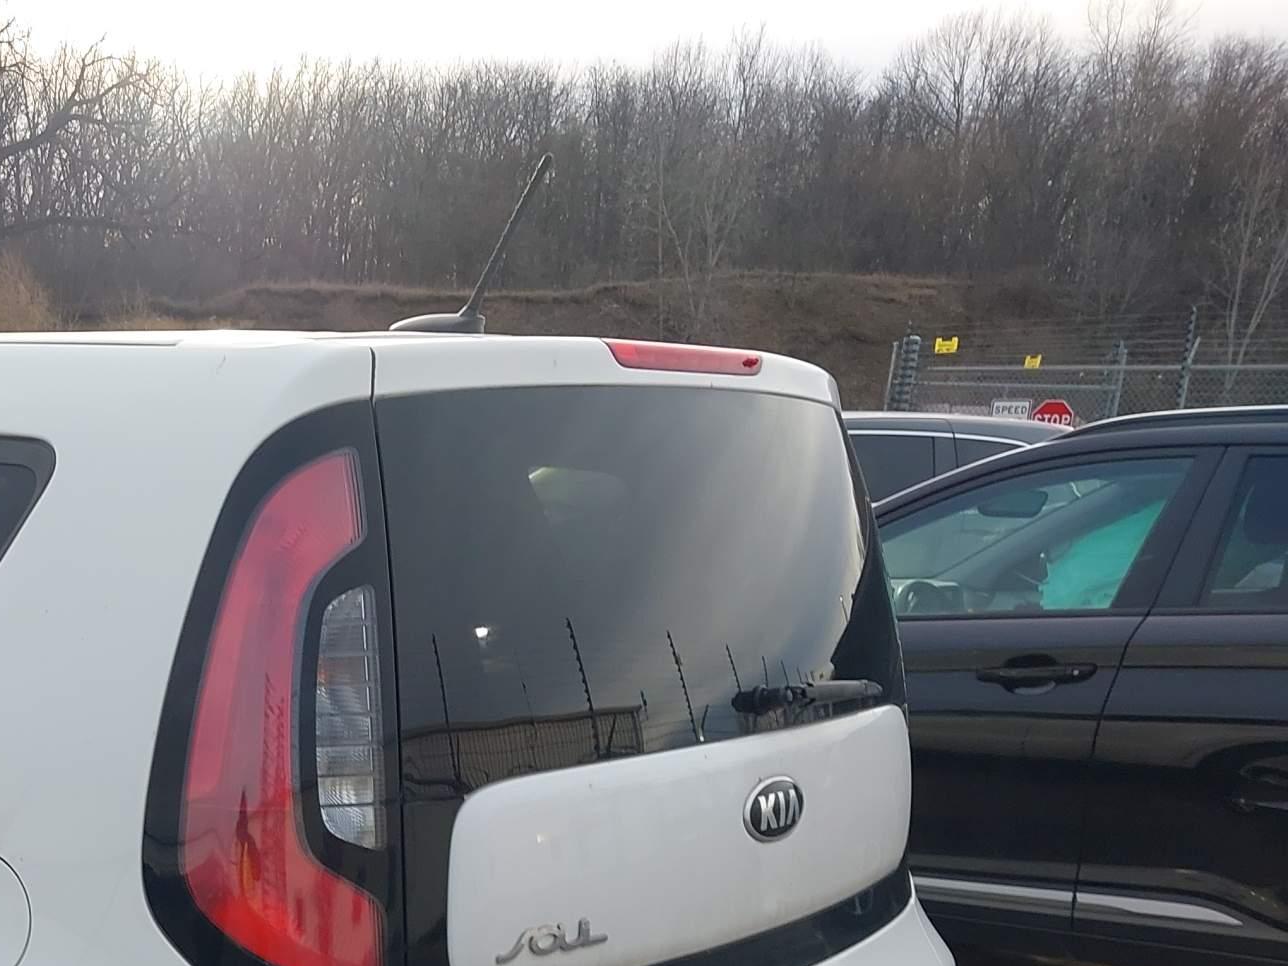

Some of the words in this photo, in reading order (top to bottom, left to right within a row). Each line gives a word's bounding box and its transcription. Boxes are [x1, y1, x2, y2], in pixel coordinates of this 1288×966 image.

[994, 405, 1028, 415] SPEED
[1034, 413, 1072, 425] STOP
[757, 788, 800, 832] KIA
[495, 918, 609, 965] SOUL
